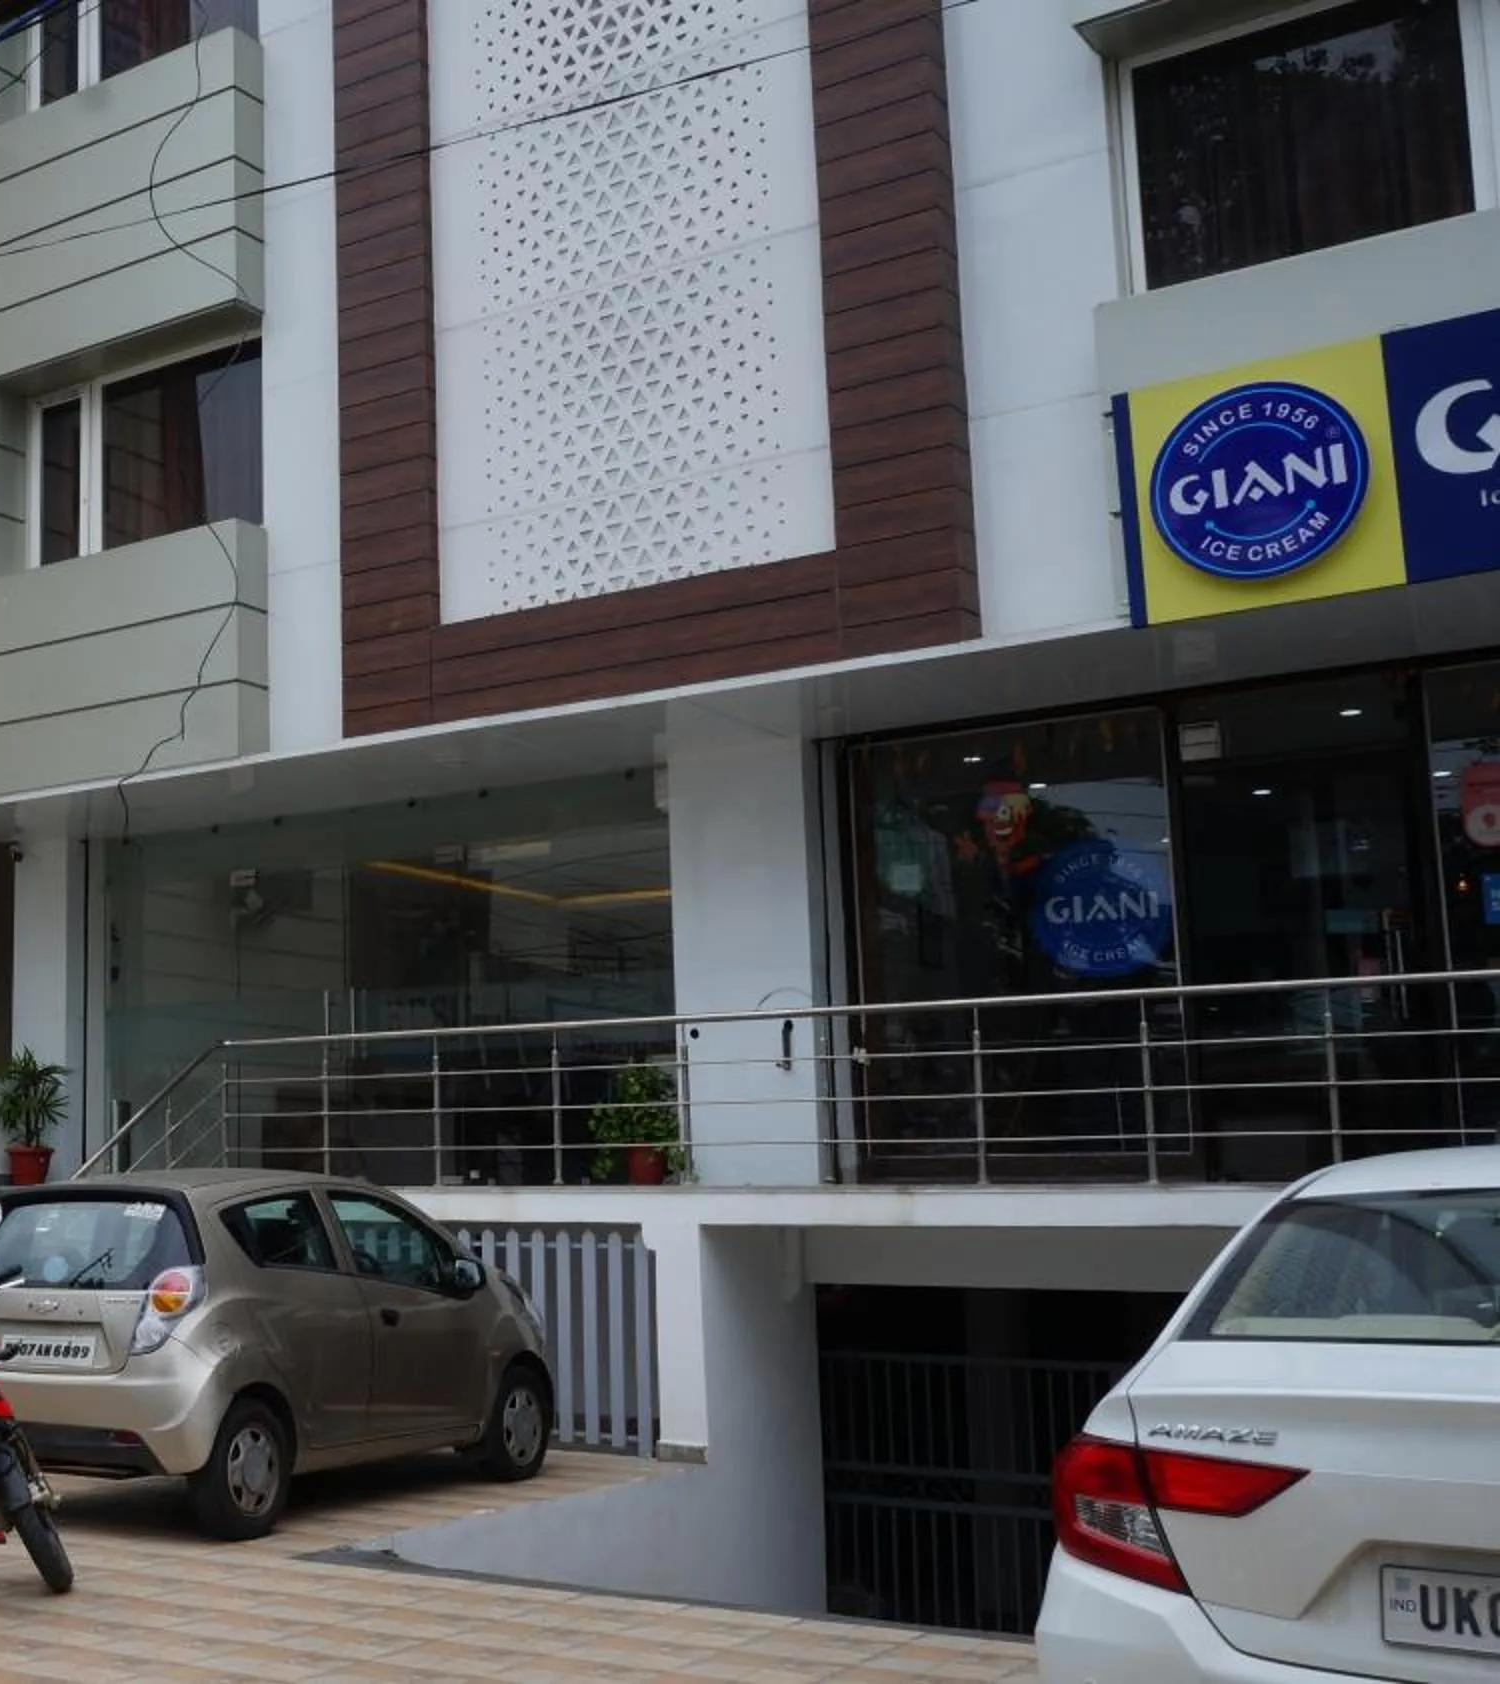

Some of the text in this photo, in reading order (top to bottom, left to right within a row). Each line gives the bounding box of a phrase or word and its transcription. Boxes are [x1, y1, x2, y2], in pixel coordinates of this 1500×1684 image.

[1182, 401, 1319, 458] SINCE 1956
[1168, 443, 1349, 516] GIANI
[1200, 511, 1331, 562] ICE CREAM
[1044, 890, 1161, 924] GIANI
[1148, 1422, 1280, 1447] AMAZE
[1389, 1598, 1417, 1613] IND
